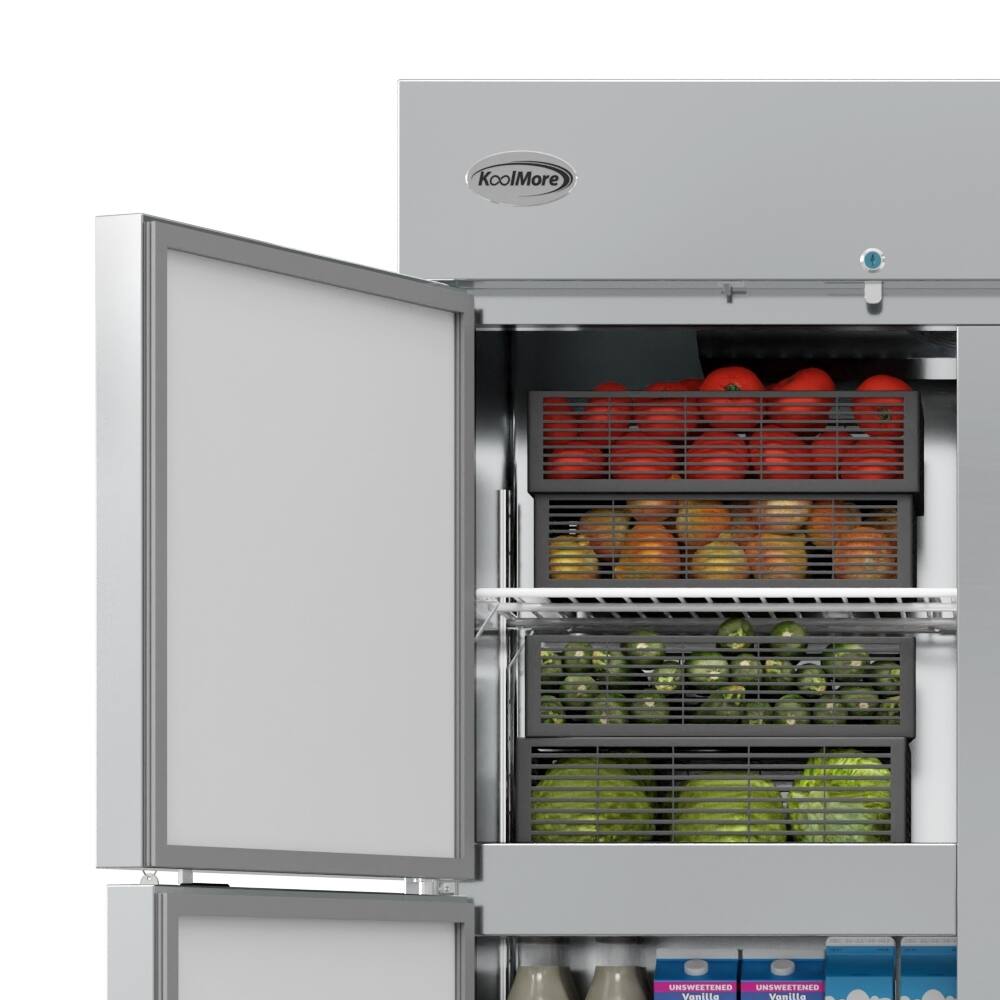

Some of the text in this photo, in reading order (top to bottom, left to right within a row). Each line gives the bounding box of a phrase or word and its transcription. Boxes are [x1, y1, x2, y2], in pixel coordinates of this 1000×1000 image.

[478, 170, 559, 186] KoolMore
[681, 993, 720, 1000] Vanilla
[768, 993, 807, 1000] Vanilla
